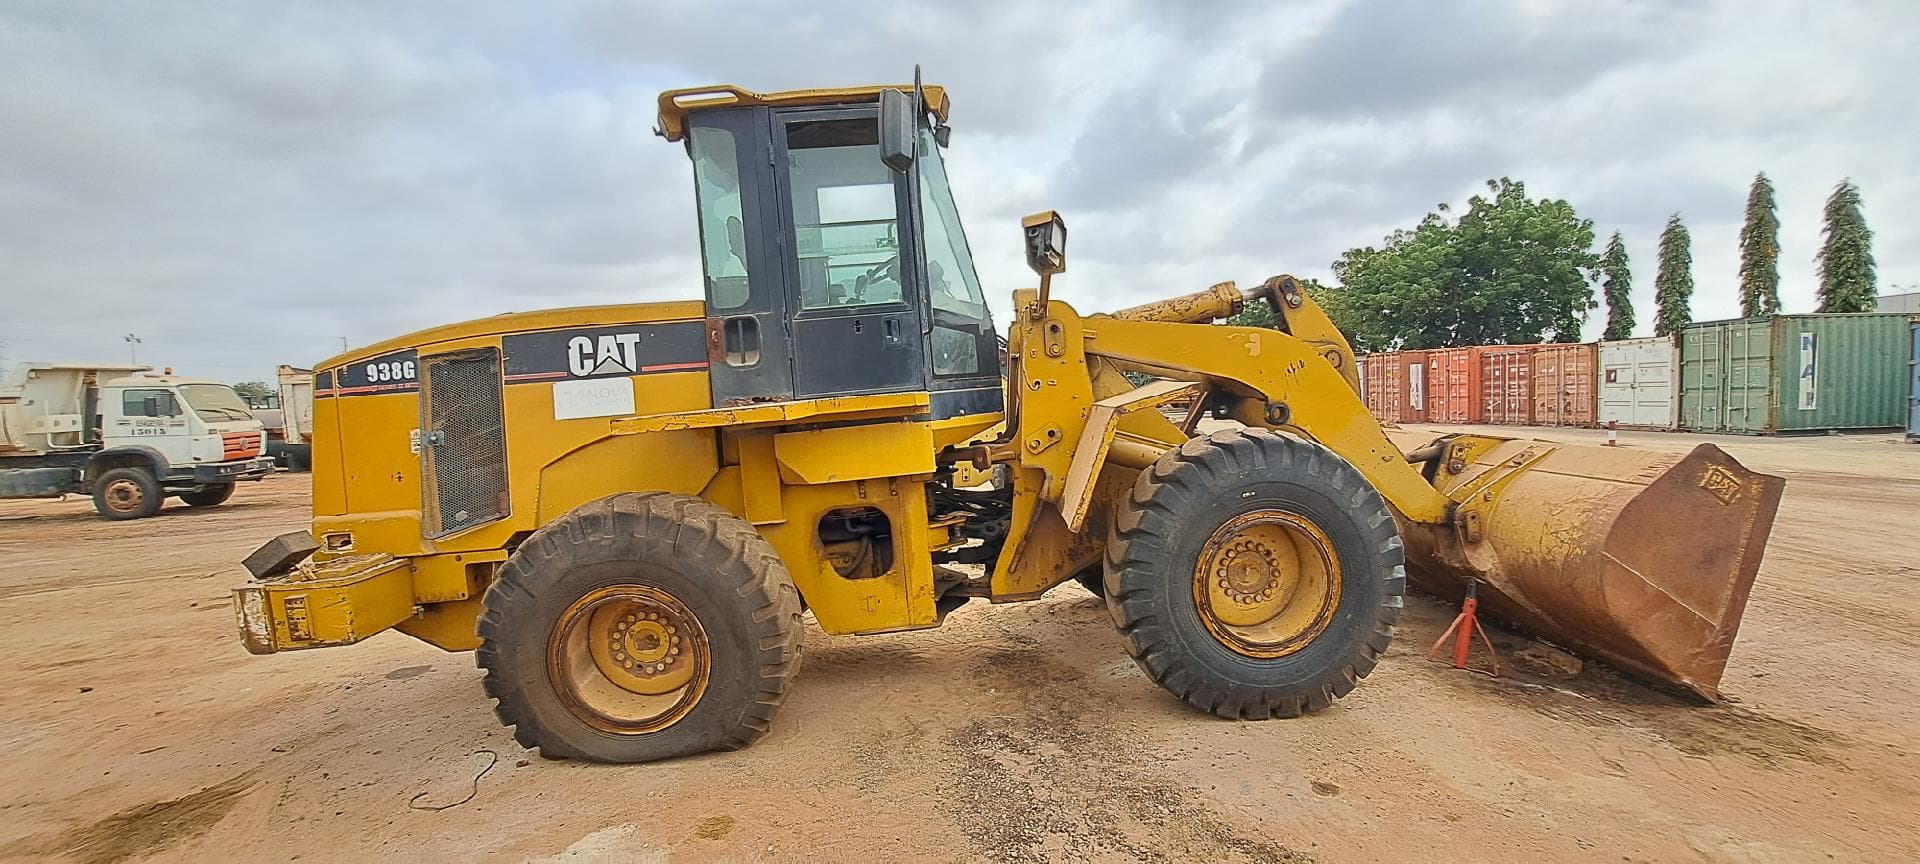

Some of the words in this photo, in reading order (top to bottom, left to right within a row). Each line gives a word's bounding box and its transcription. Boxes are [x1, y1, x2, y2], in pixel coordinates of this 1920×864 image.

[568, 333, 640, 377] CAT
[366, 360, 416, 382] 938G
[588, 386, 631, 399] NOVA
